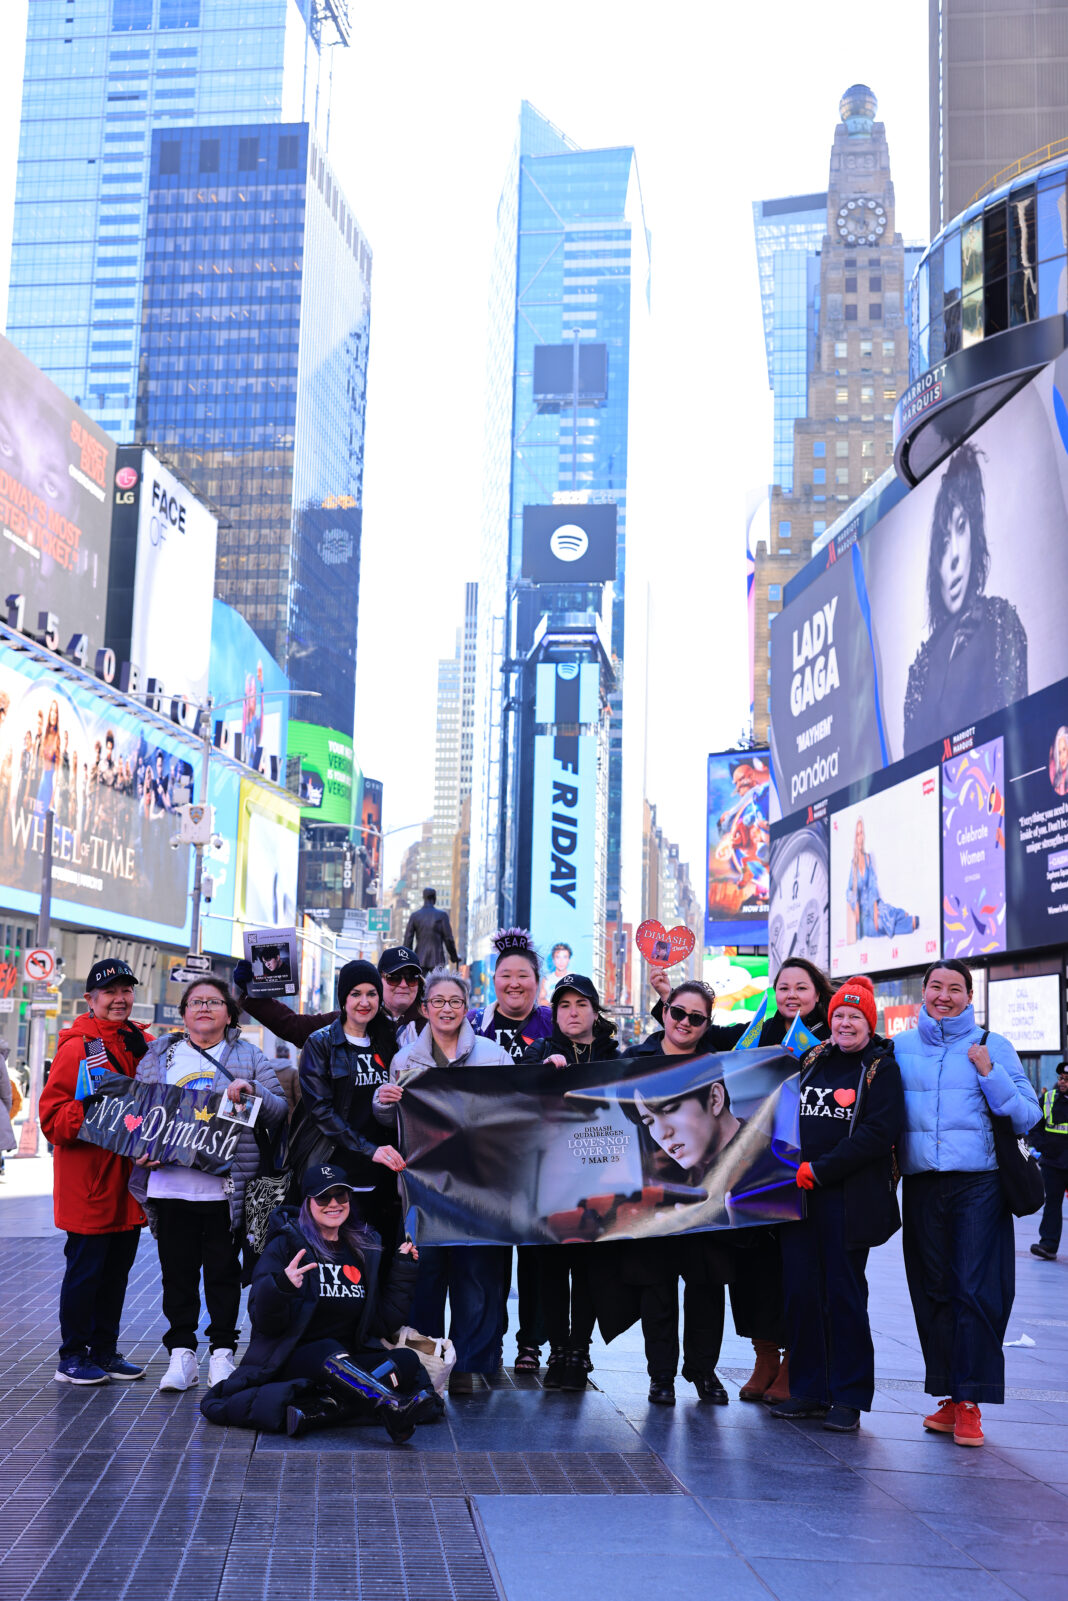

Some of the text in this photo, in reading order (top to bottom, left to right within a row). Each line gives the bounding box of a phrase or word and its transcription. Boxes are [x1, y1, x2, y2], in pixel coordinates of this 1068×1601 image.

[116, 492, 134, 504] LG
[152, 480, 186, 534] FACE
[6, 594, 116, 683] 1540
[793, 596, 838, 672] LADY
[790, 647, 840, 717] GAGA
[791, 751, 839, 804] pandora
[10, 806, 82, 865] WHEEL
[81, 842, 91, 857] OF
[90, 835, 136, 880] TIME
[550, 757, 579, 909] FRIDAY
[956, 824, 988, 846] Celebrate
[343, 851, 352, 888] 1500
[959, 849, 985, 867] Women
[496, 937, 527, 951] DEAR
[644, 930, 687, 945] DIMASH
[86, 1095, 238, 1161] NY Dimash
[568, 1136, 631, 1149] LOVE'S NOT
[573, 1130, 624, 1139] QUDAIBERGEN
[573, 1145, 627, 1157] OVER YET
[581, 1155, 620, 1165] 7 MAR 25
